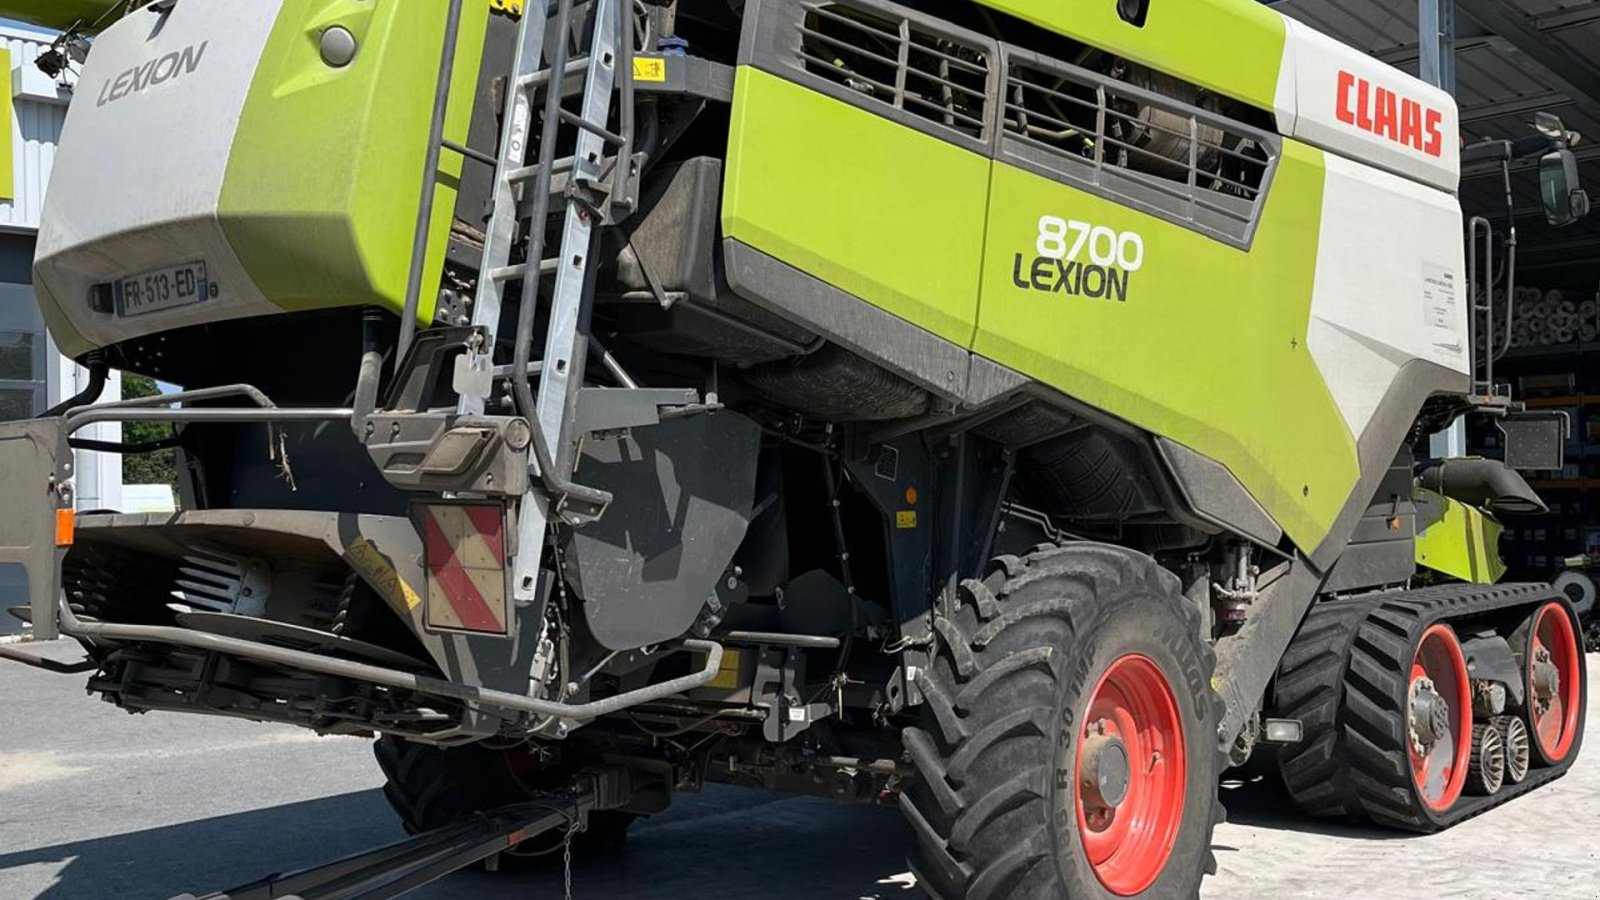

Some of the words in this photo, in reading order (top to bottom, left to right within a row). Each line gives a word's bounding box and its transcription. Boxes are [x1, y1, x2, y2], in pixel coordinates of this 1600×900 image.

[96, 41, 208, 107] LEXION
[1337, 70, 1441, 157] CLAAS
[1036, 215, 1144, 271] 8700
[124, 268, 195, 309] FR-513-ED
[1013, 252, 1129, 302] LEXION
[1059, 708, 1075, 750] 30
